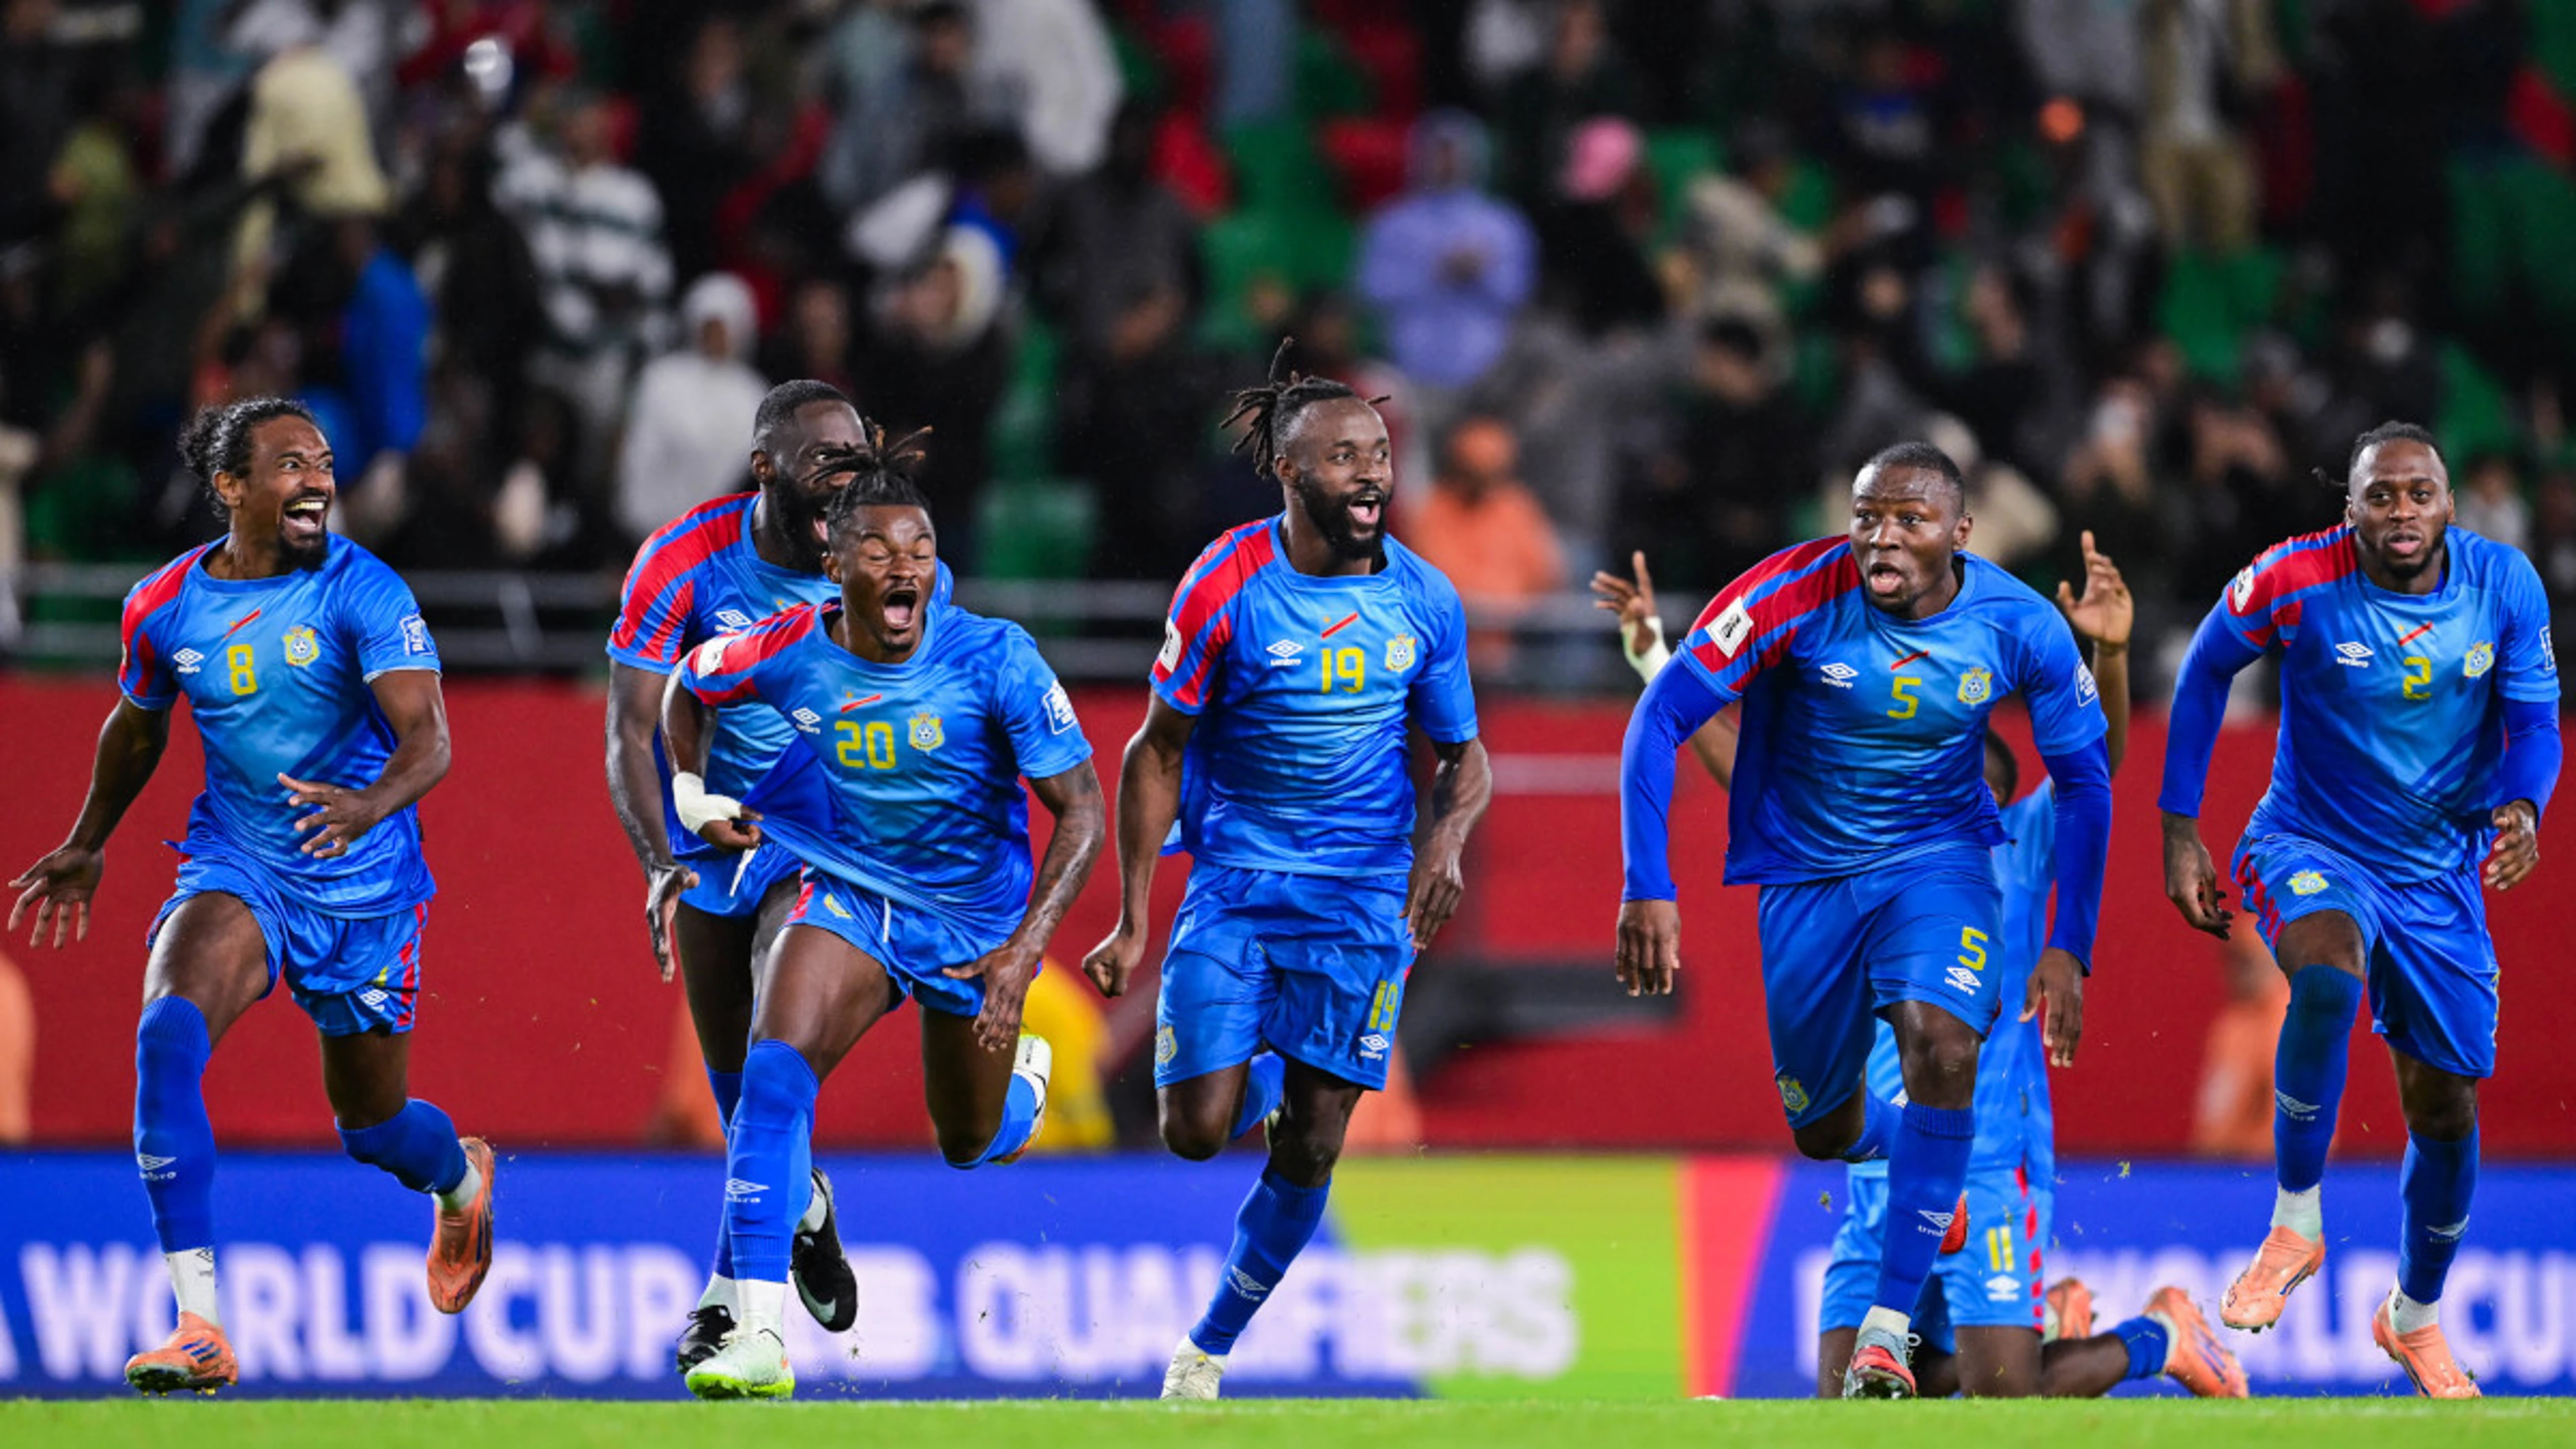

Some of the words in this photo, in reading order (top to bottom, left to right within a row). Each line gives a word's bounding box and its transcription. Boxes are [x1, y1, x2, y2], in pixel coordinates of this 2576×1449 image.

[227, 643, 257, 696] 8
[1321, 647, 1364, 694] 19
[2402, 656, 2431, 699] 2
[1887, 676, 1922, 719] 5
[835, 720, 896, 769] 20
[1957, 926, 1988, 971] 5
[1368, 979, 1399, 1032] 19
[1986, 1226, 2015, 1272] 11
[463, 1240, 702, 1383] CUP
